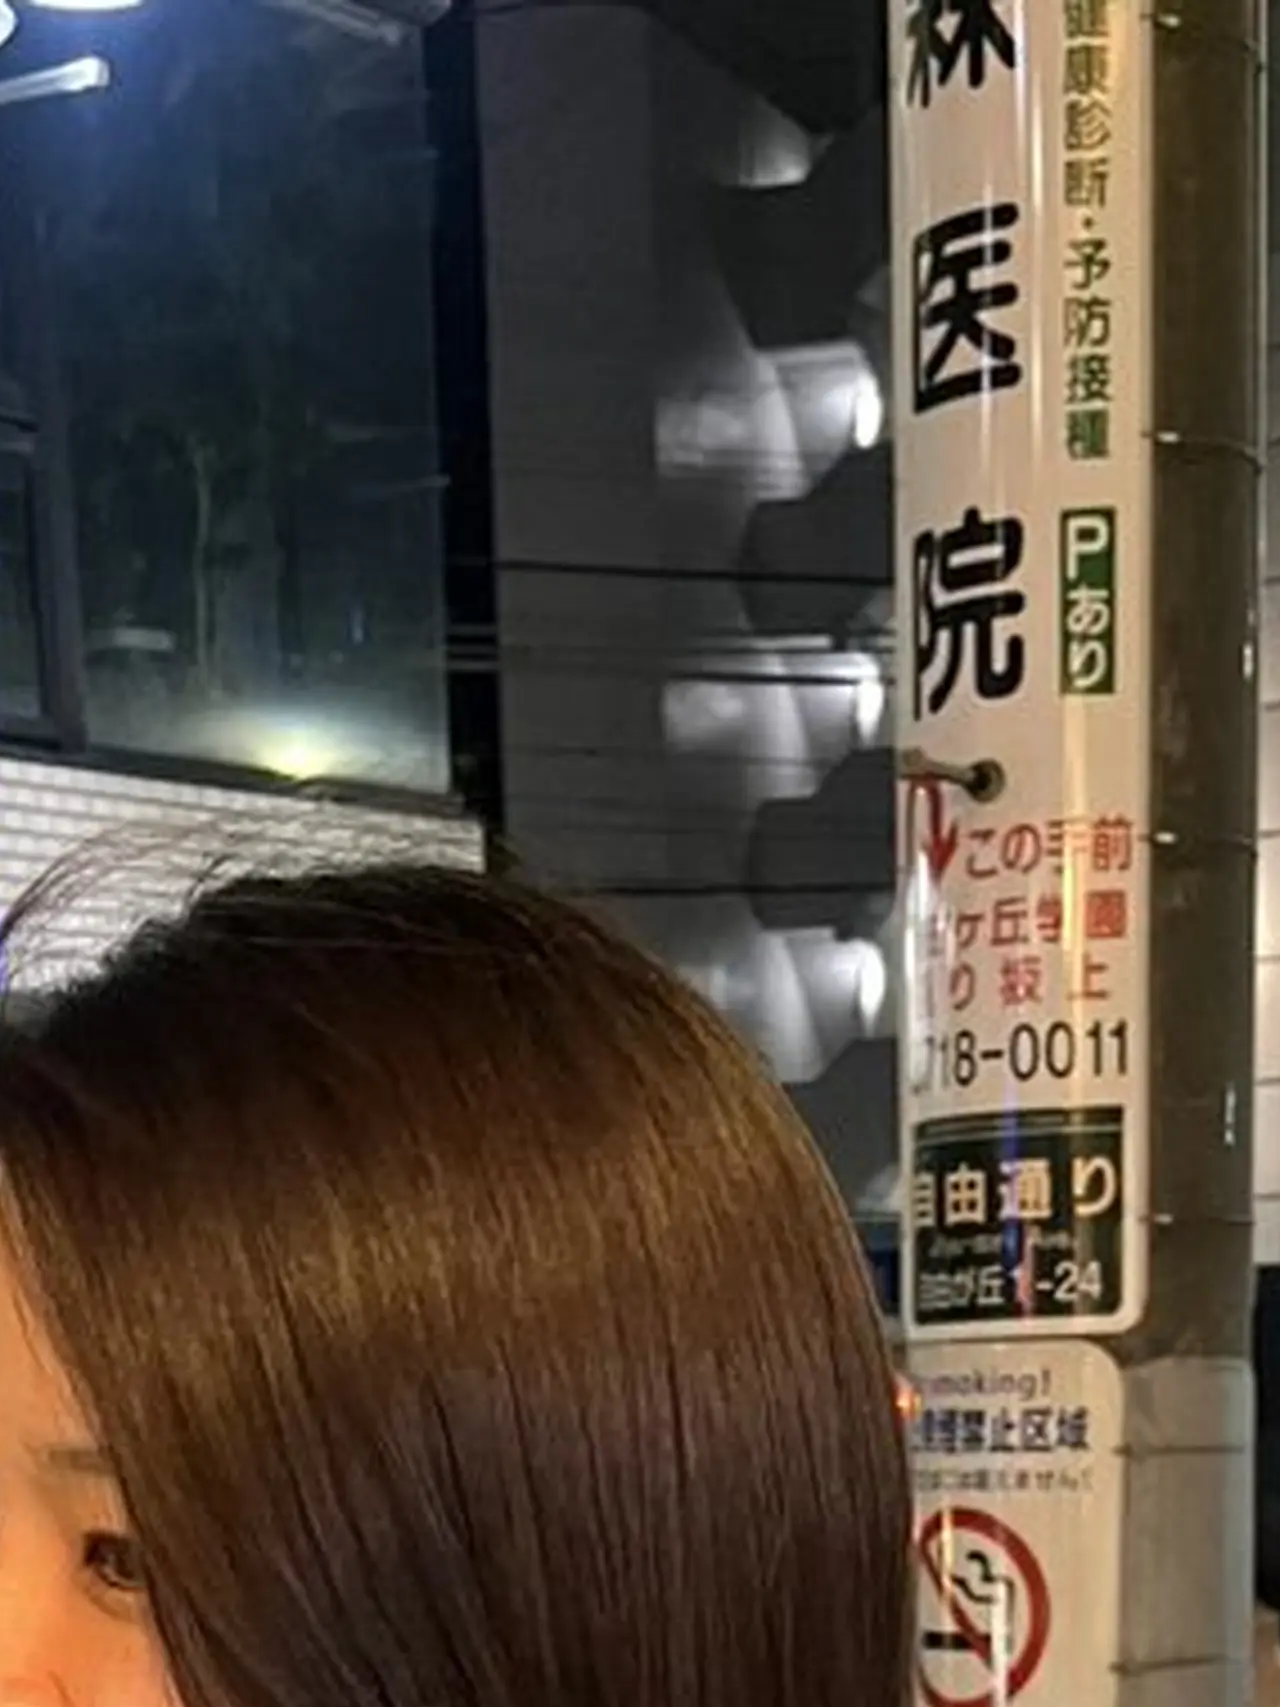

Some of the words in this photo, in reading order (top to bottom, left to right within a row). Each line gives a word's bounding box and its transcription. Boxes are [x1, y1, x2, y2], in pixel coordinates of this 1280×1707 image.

[1065, 516, 1111, 690] Pあり
[965, 815, 1133, 879] この手前
[915, 1018, 1129, 1093] 18-0011
